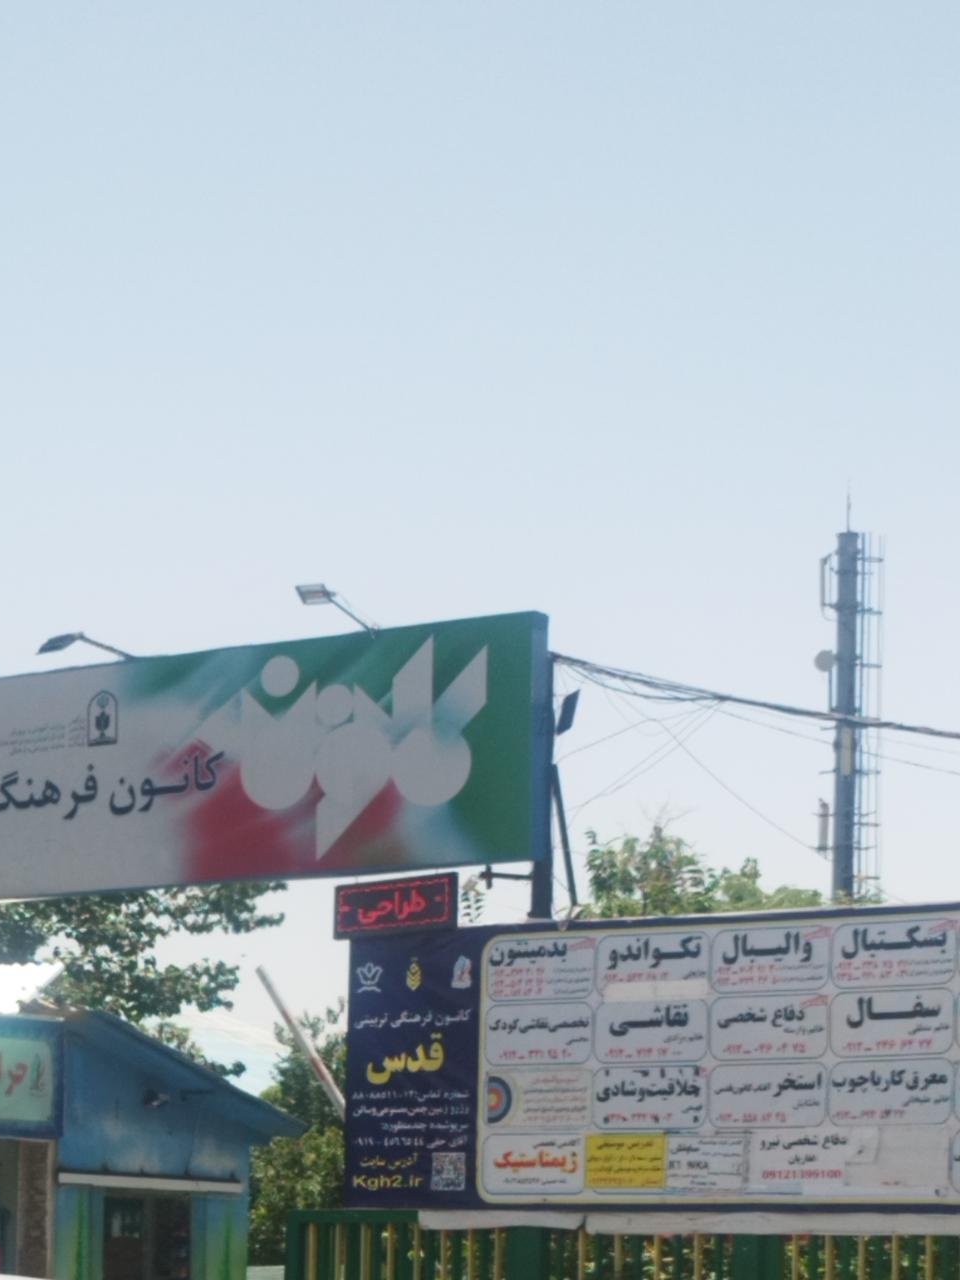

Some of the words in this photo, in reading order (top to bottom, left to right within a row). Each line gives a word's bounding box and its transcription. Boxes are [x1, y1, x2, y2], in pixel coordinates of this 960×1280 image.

[109, 751, 225, 816] کانون
[358, 889, 427, 924] طراحی
[489, 941, 568, 967] بدمینتون
[607, 936, 702, 970] تکواندو
[722, 931, 812, 965] والیبال
[841, 925, 947, 959] بسکتبال
[354, 1013, 388, 1029] تربیتی
[390, 1010, 432, 1028] فرهنگی
[434, 1008, 472, 1026] کانون
[609, 1003, 689, 1037] نقاشی
[717, 1007, 768, 1029] شخصی
[771, 1004, 805, 1028] دفاع
[846, 995, 942, 1029] سفال
[367, 1031, 445, 1086] قدس
[596, 1080, 638, 1102] شادی
[772, 1072, 822, 1098] استخر
[831, 1075, 869, 1093] چوب
[906, 1071, 948, 1091] معرق
[493, 1150, 578, 1174] ژیمناستیک
